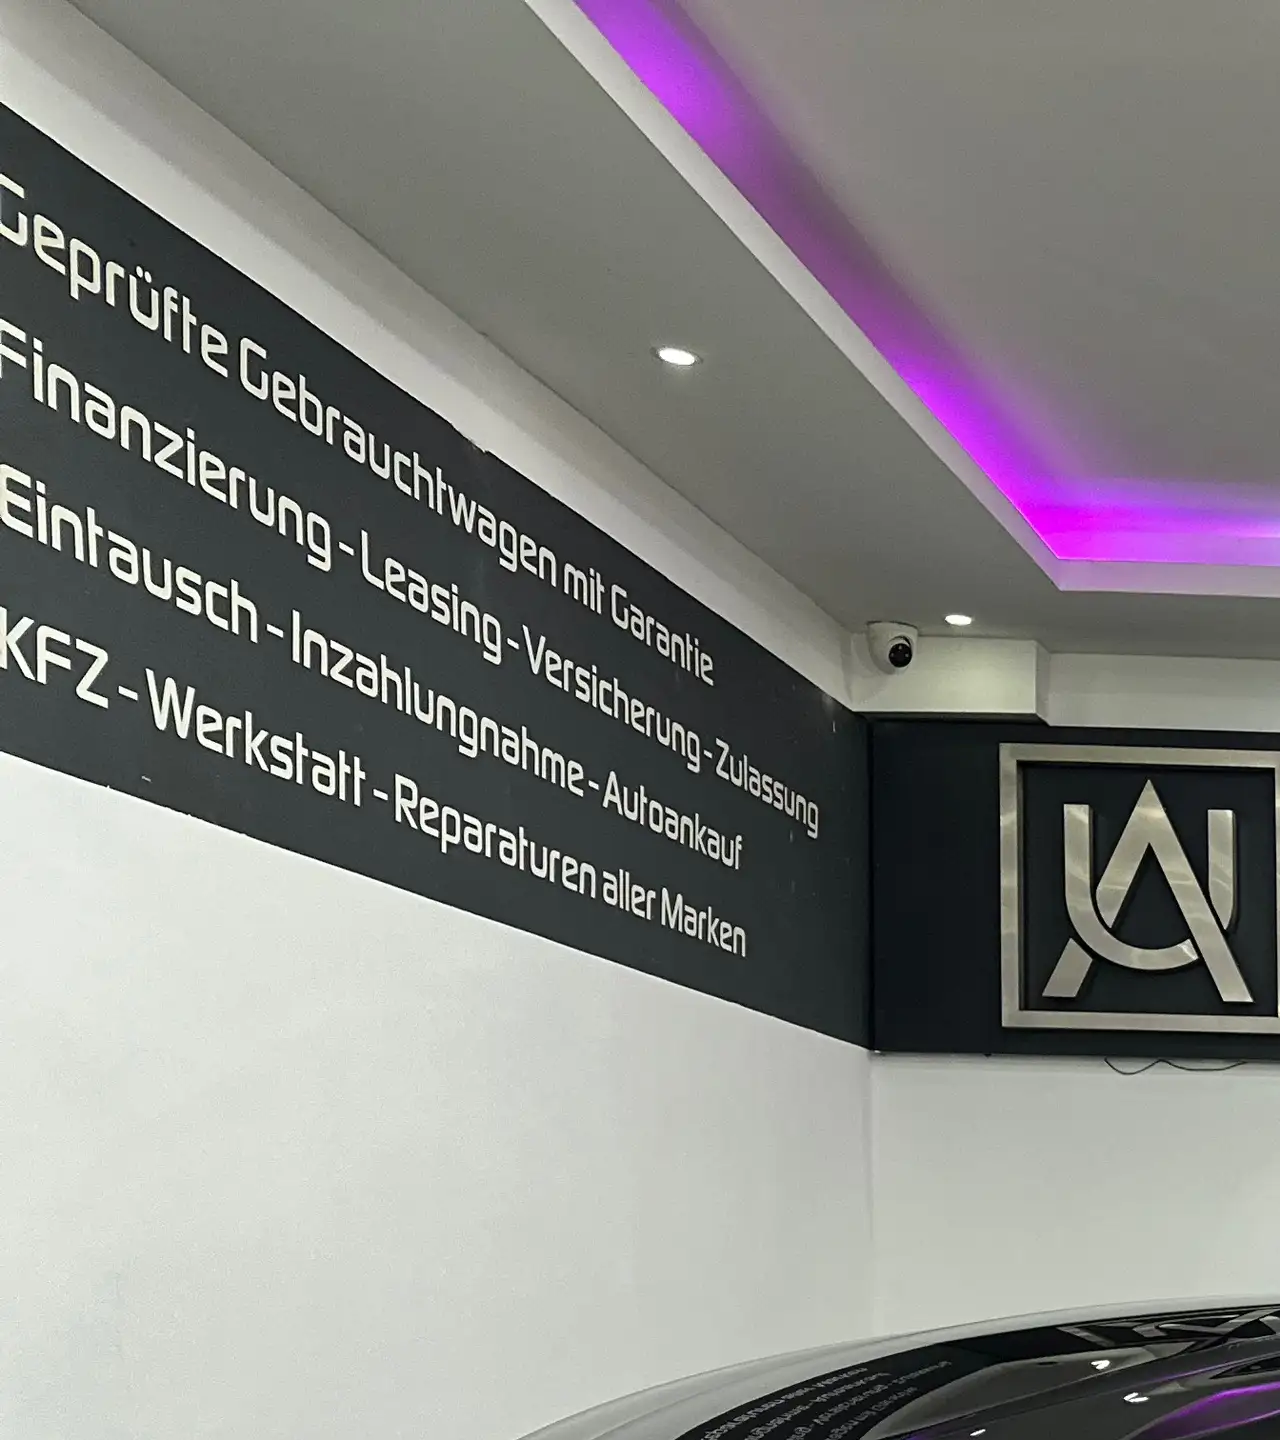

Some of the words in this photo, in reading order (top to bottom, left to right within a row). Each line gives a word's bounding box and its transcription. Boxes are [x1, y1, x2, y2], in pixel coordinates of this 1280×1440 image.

[0, 173, 228, 378] Geprüfte
[240, 337, 557, 588] Gebrauchtwagen
[563, 562, 604, 614] mit
[611, 584, 714, 687] Garantie
[0, 318, 331, 572] Finanzierung
[360, 529, 502, 666] Leasing
[521, 624, 700, 774] Versicherung
[715, 737, 819, 839] Zulassung
[0, 463, 258, 643] Eintausch
[291, 609, 584, 797] Inzahlungnahme
[602, 770, 743, 870] Autoankauf
[0, 606, 110, 708] KFZ
[145, 667, 366, 807] Werkstatt
[394, 772, 596, 898] Reparaturen
[602, 868, 656, 921] aller
[660, 886, 746, 958] Marken
